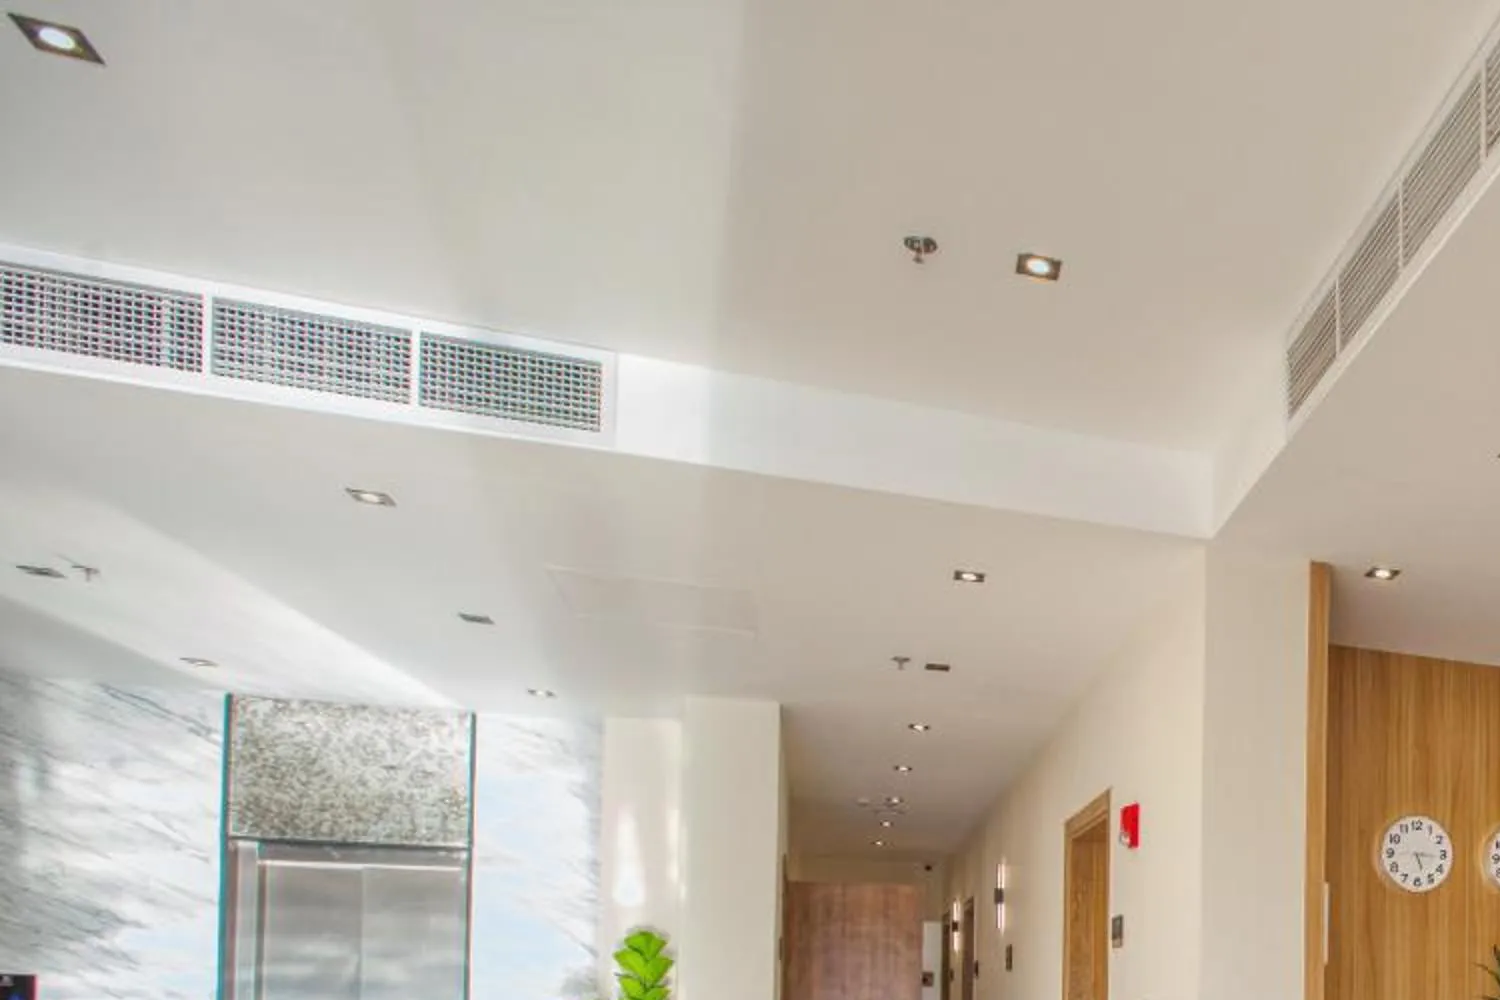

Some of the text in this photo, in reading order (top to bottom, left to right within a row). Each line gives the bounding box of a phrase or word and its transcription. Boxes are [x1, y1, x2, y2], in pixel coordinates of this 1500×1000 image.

[1400, 824, 1409, 834] 11
[1411, 820, 1423, 831] 12
[1389, 833, 1401, 844] 10
[1435, 835, 1443, 844] 2
[1386, 847, 1395, 859] 9
[1440, 849, 1447, 860] 3
[1491, 853, 1500, 864] 9
[1389, 861, 1399, 872] 8
[1435, 864, 1443, 874] 4
[1401, 872, 1409, 883] 7
[1413, 877, 1422, 887] 6
